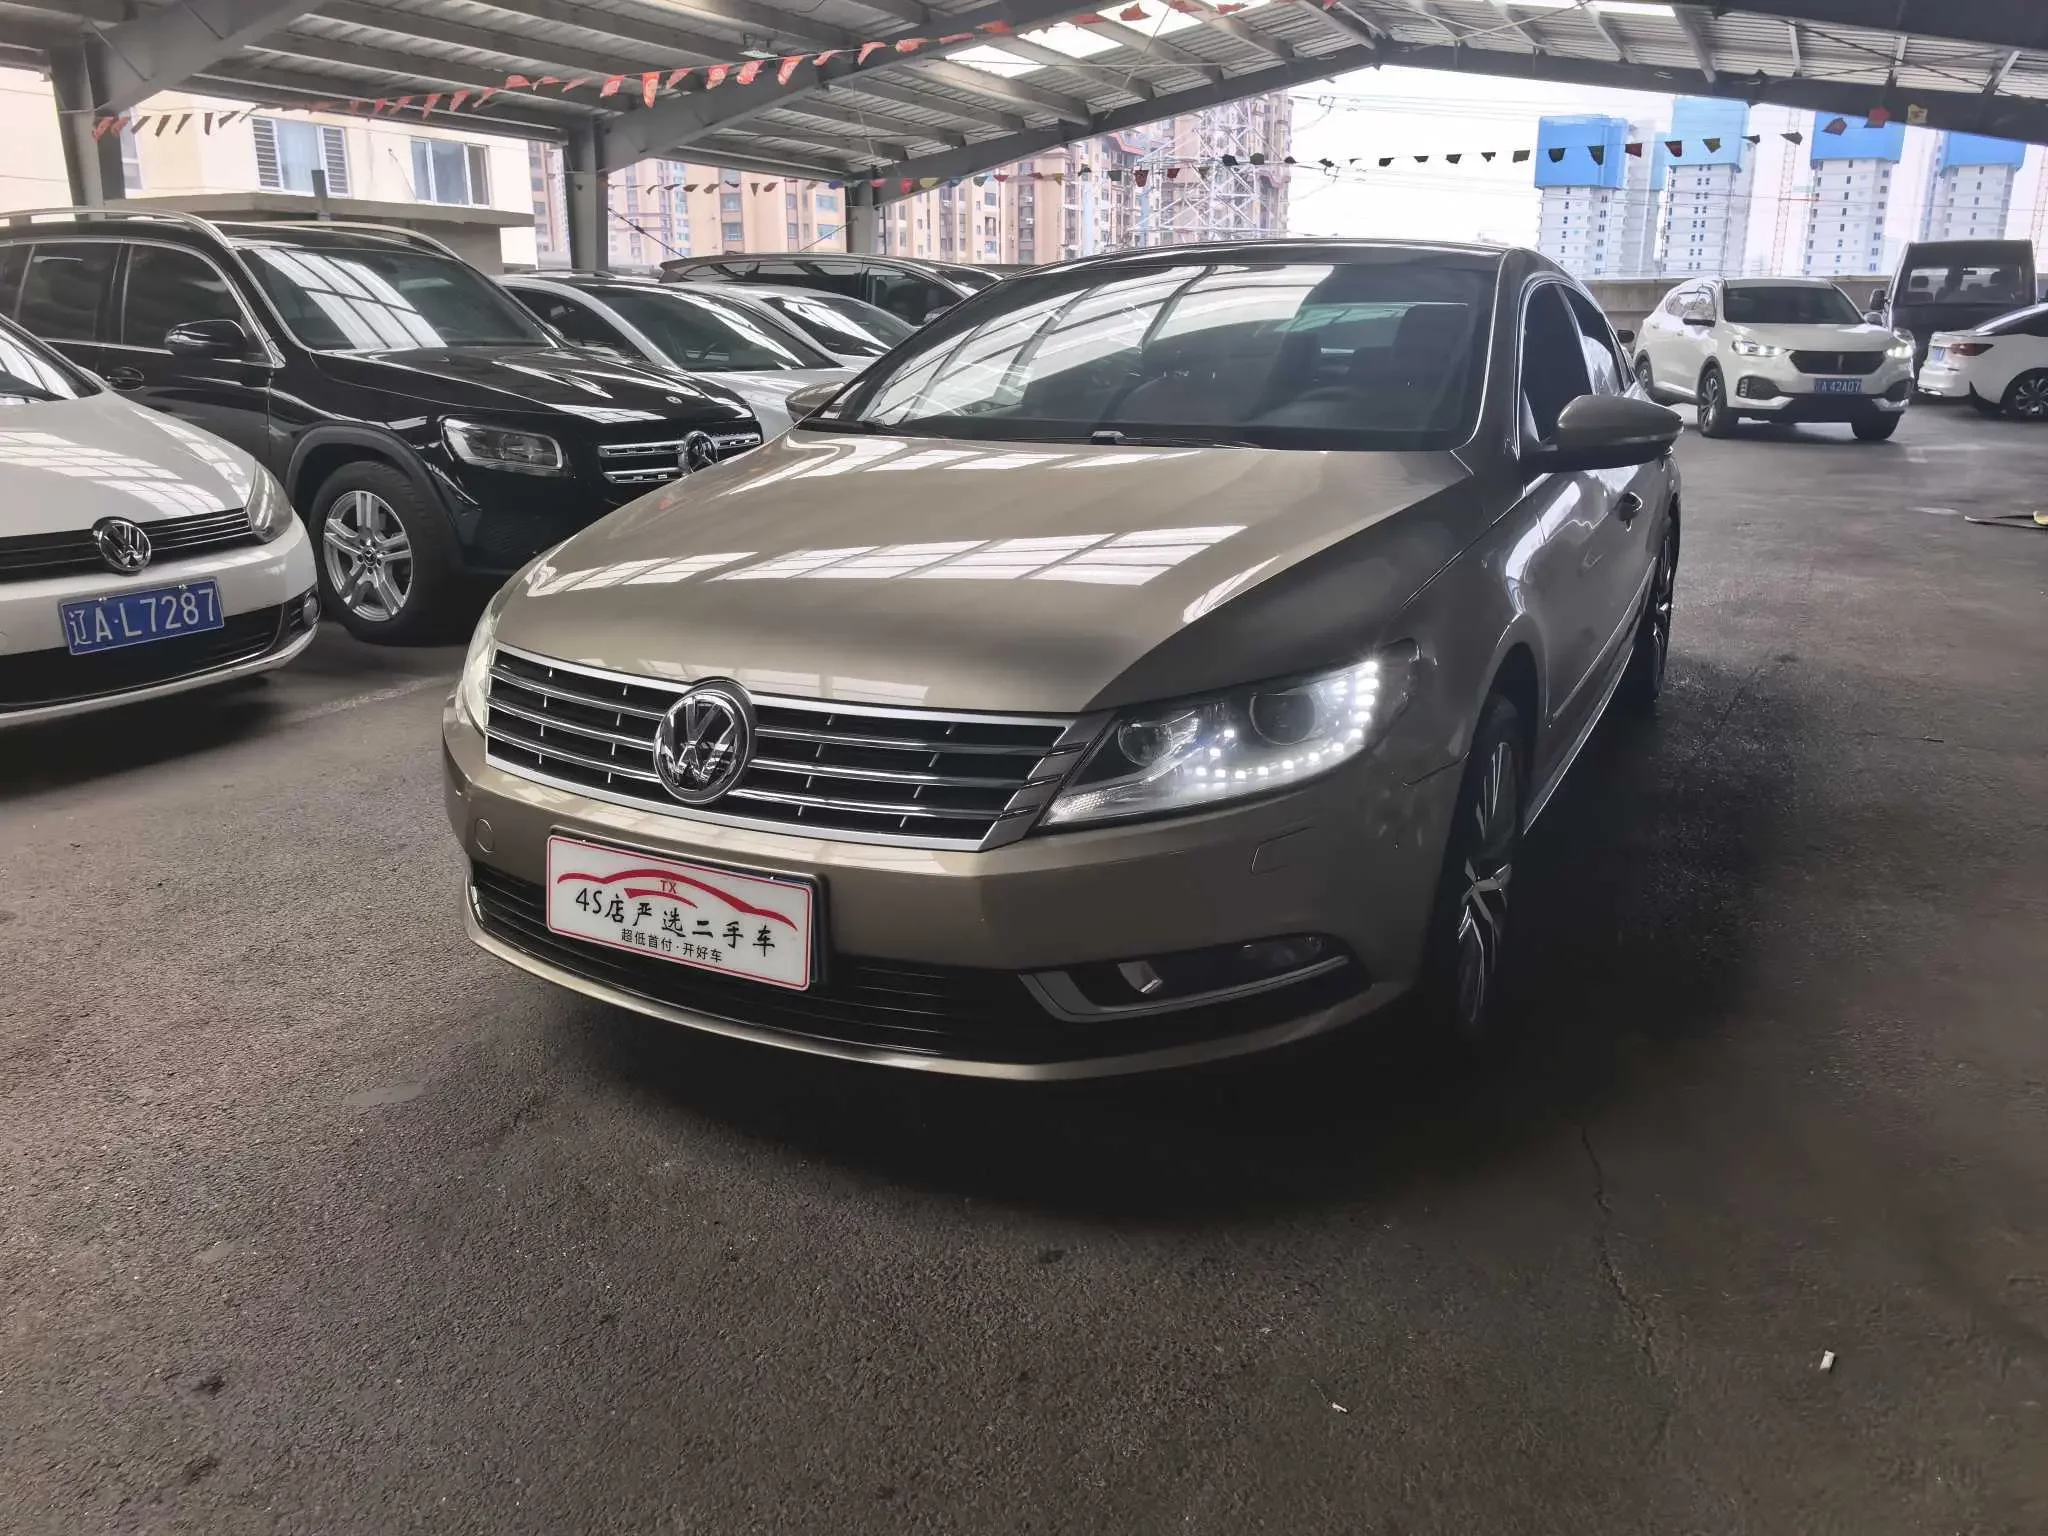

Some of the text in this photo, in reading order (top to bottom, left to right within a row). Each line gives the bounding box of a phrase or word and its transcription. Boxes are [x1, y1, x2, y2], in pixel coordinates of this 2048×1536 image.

[659, 879, 678, 894] TX
[575, 887, 776, 957] 4S店严选二手车
